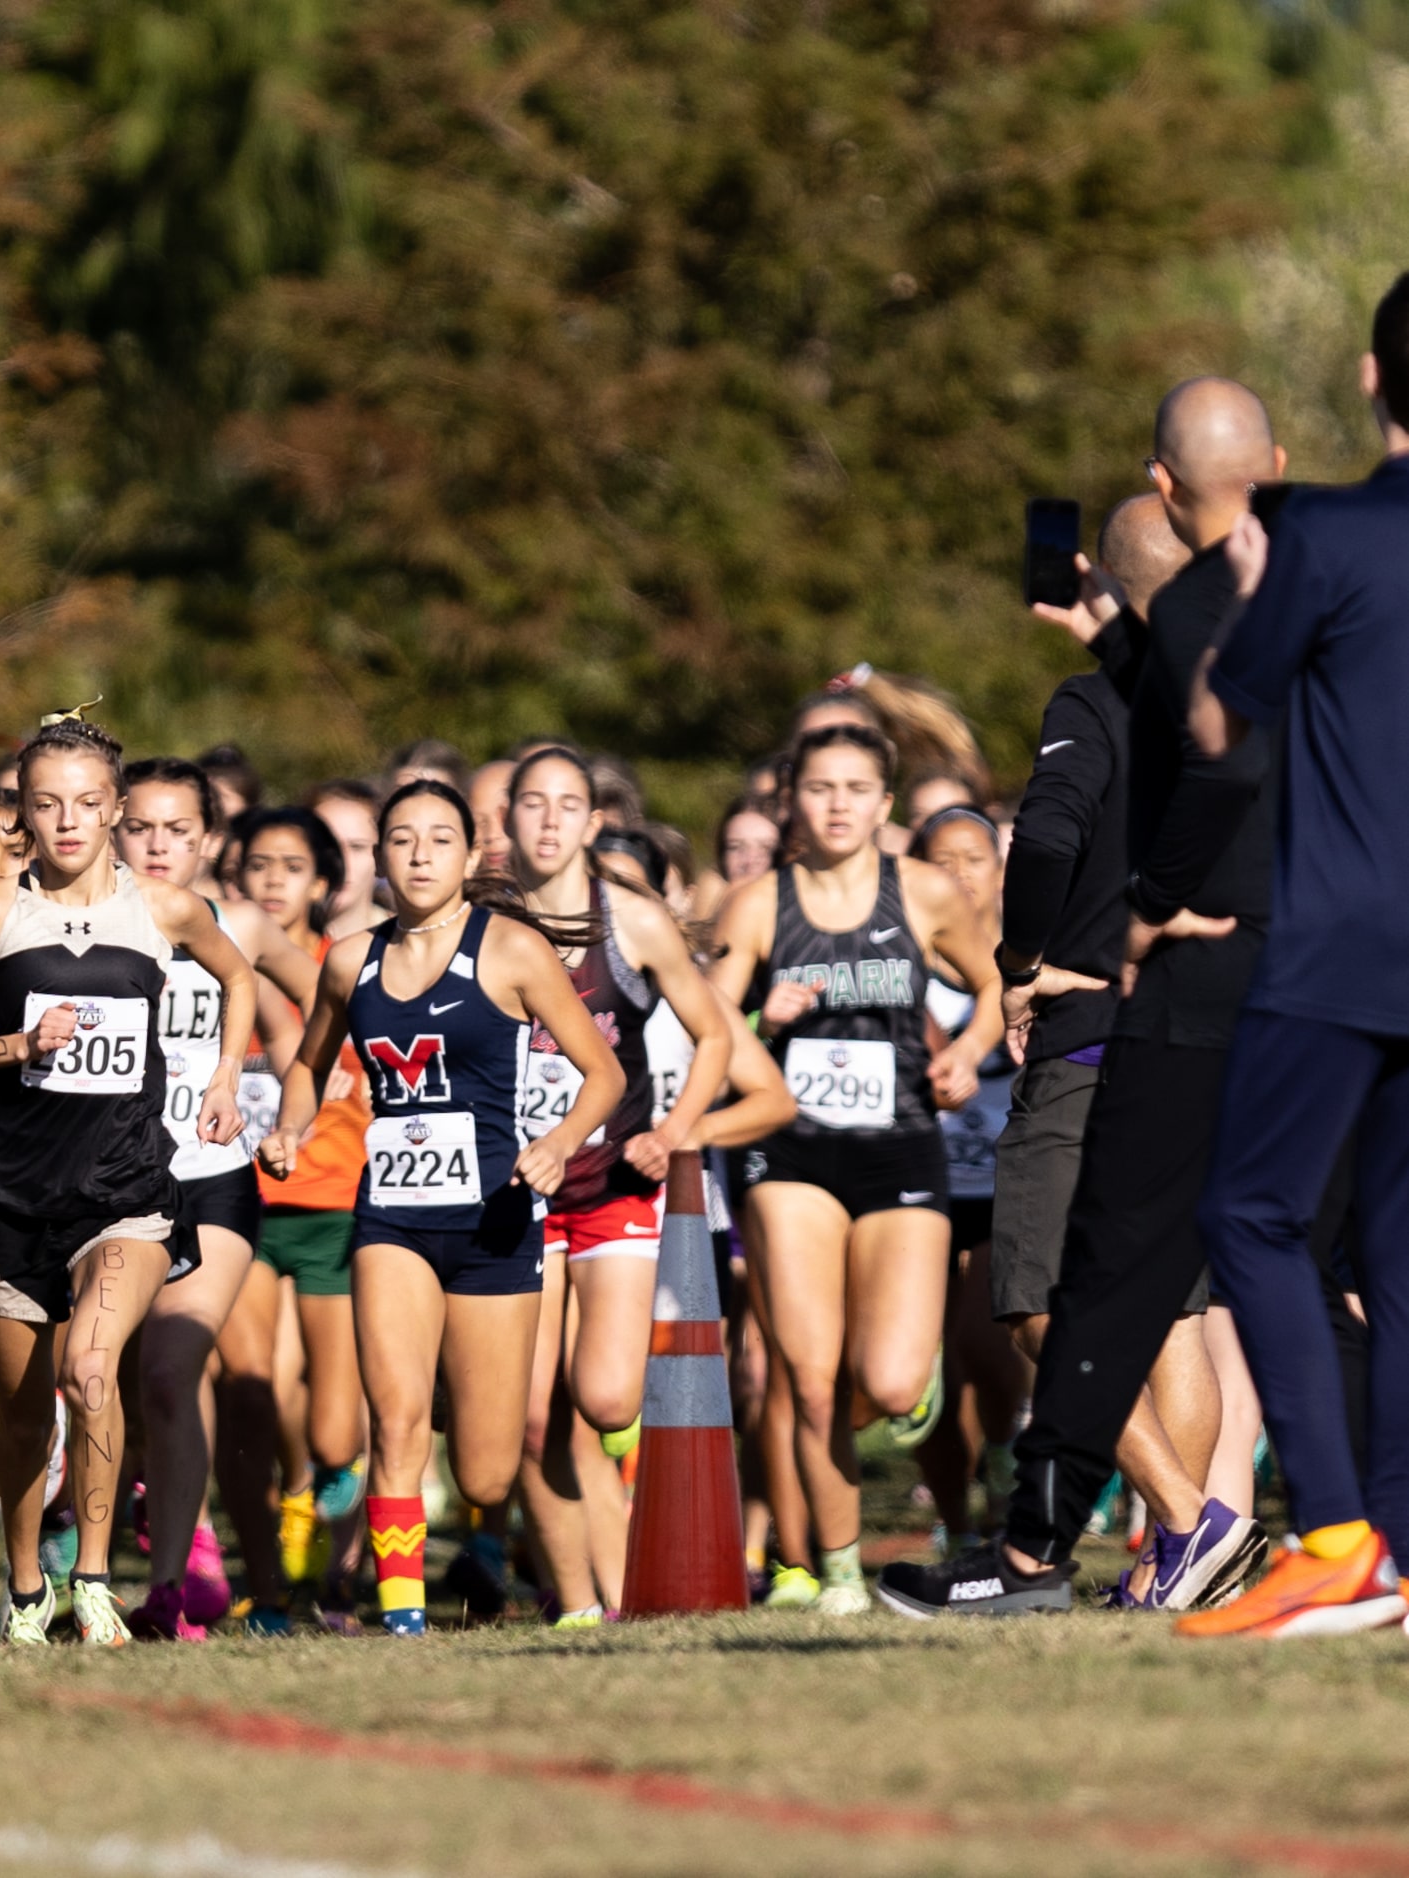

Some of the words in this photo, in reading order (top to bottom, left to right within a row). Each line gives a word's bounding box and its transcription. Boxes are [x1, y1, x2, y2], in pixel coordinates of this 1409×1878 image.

[365, 1034, 451, 1104] M
[795, 1072, 883, 1110] 2299
[375, 1149, 470, 1187] 2224
[83, 1244, 125, 1524] BELONG
[949, 1577, 1005, 1601] HOKA
